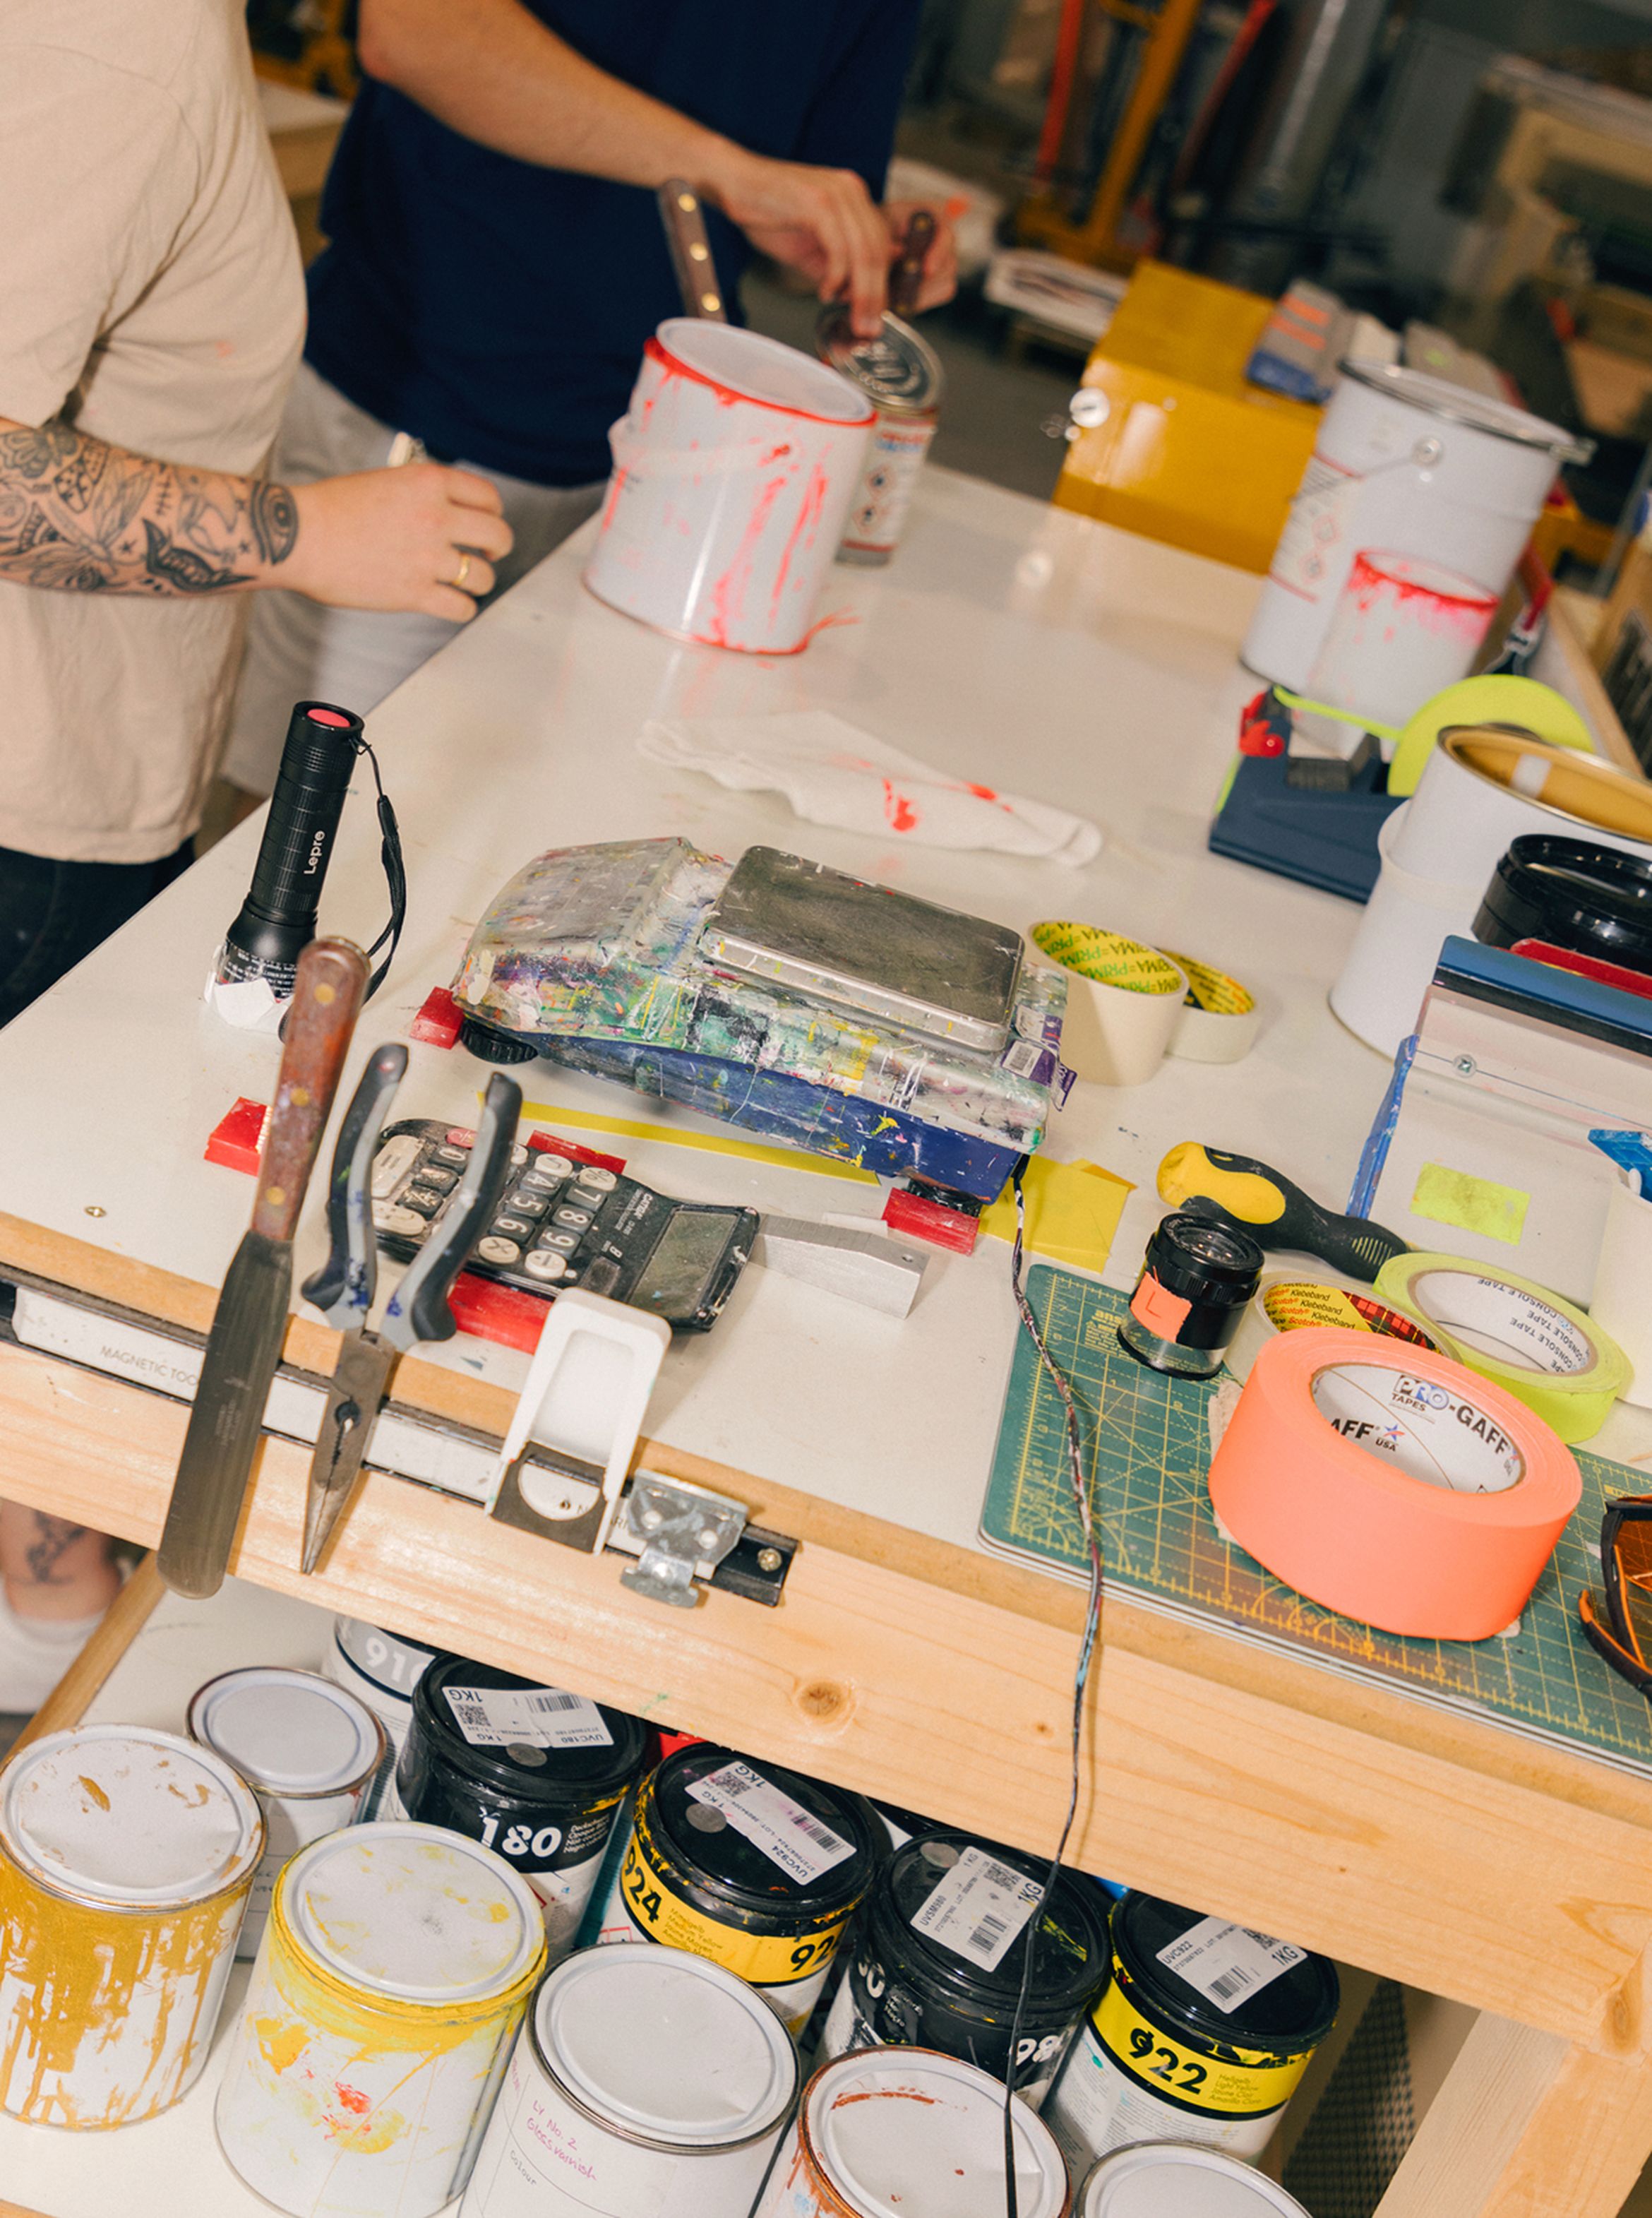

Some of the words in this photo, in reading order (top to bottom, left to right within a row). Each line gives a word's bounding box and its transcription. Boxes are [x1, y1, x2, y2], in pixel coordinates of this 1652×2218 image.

[513, 1195, 543, 1212] 5
[558, 1210, 588, 1224] 8
[1290, 1290, 1331, 1301] Klebeband
[1300, 1300, 1343, 1316] Klebeband
[1311, 1311, 1355, 1329] Klebeband
[1509, 1318, 1535, 1338] TAPE
[1526, 1310, 1552, 1330] TAPE
[1538, 1334, 1573, 1369] CONSOLE
[100, 1345, 167, 1377] MAGNETIC
[171, 1368, 198, 1386] TOO
[1391, 1393, 1426, 1412] TAPES
[1375, 1438, 1396, 1452] USA
[448, 1689, 483, 1703] 1KG
[735, 1765, 766, 1788] 1KG
[481, 1816, 562, 1857] 180
[772, 1845, 808, 1878] UVC924
[626, 1846, 662, 1923] 924
[791, 1936, 836, 1972] 92
[1163, 1940, 1194, 1964] UVC922
[1271, 1945, 1298, 1966] 1KG
[1129, 2027, 1207, 2095] 922
[568, 2137, 577, 2151] 2
[510, 2150, 537, 2186] Colour
